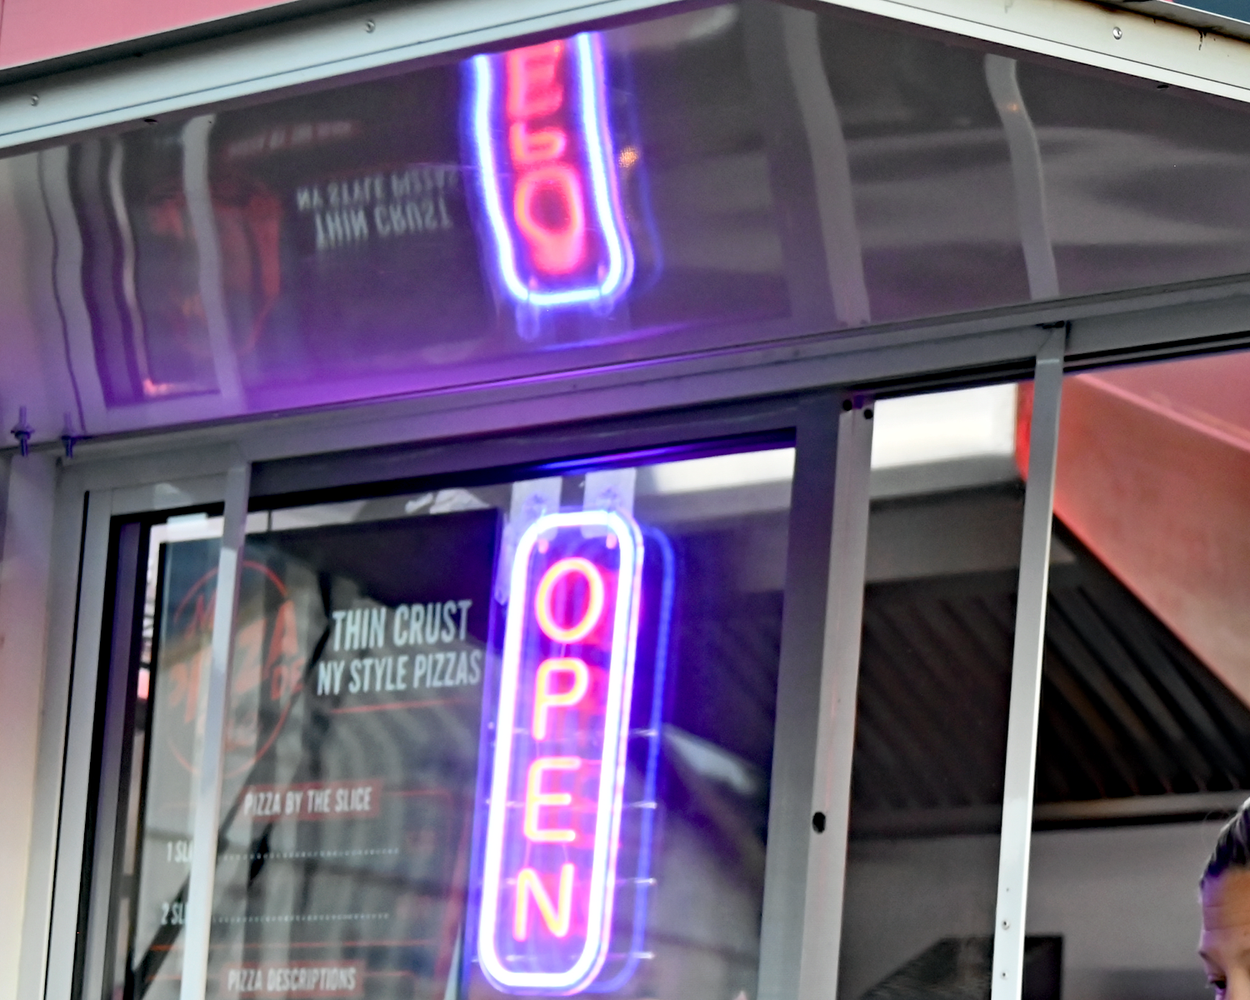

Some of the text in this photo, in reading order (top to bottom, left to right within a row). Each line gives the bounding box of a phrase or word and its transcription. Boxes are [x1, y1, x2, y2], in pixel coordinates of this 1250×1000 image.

[332, 599, 473, 651] THIN CRUST
[317, 649, 483, 696] NY STYLE PIZZAS
[512, 556, 605, 943] OPEN
[243, 786, 373, 816] PIZZA BY THE SLICE
[228, 967, 357, 992] PIZZA DESCRIPTIONS
